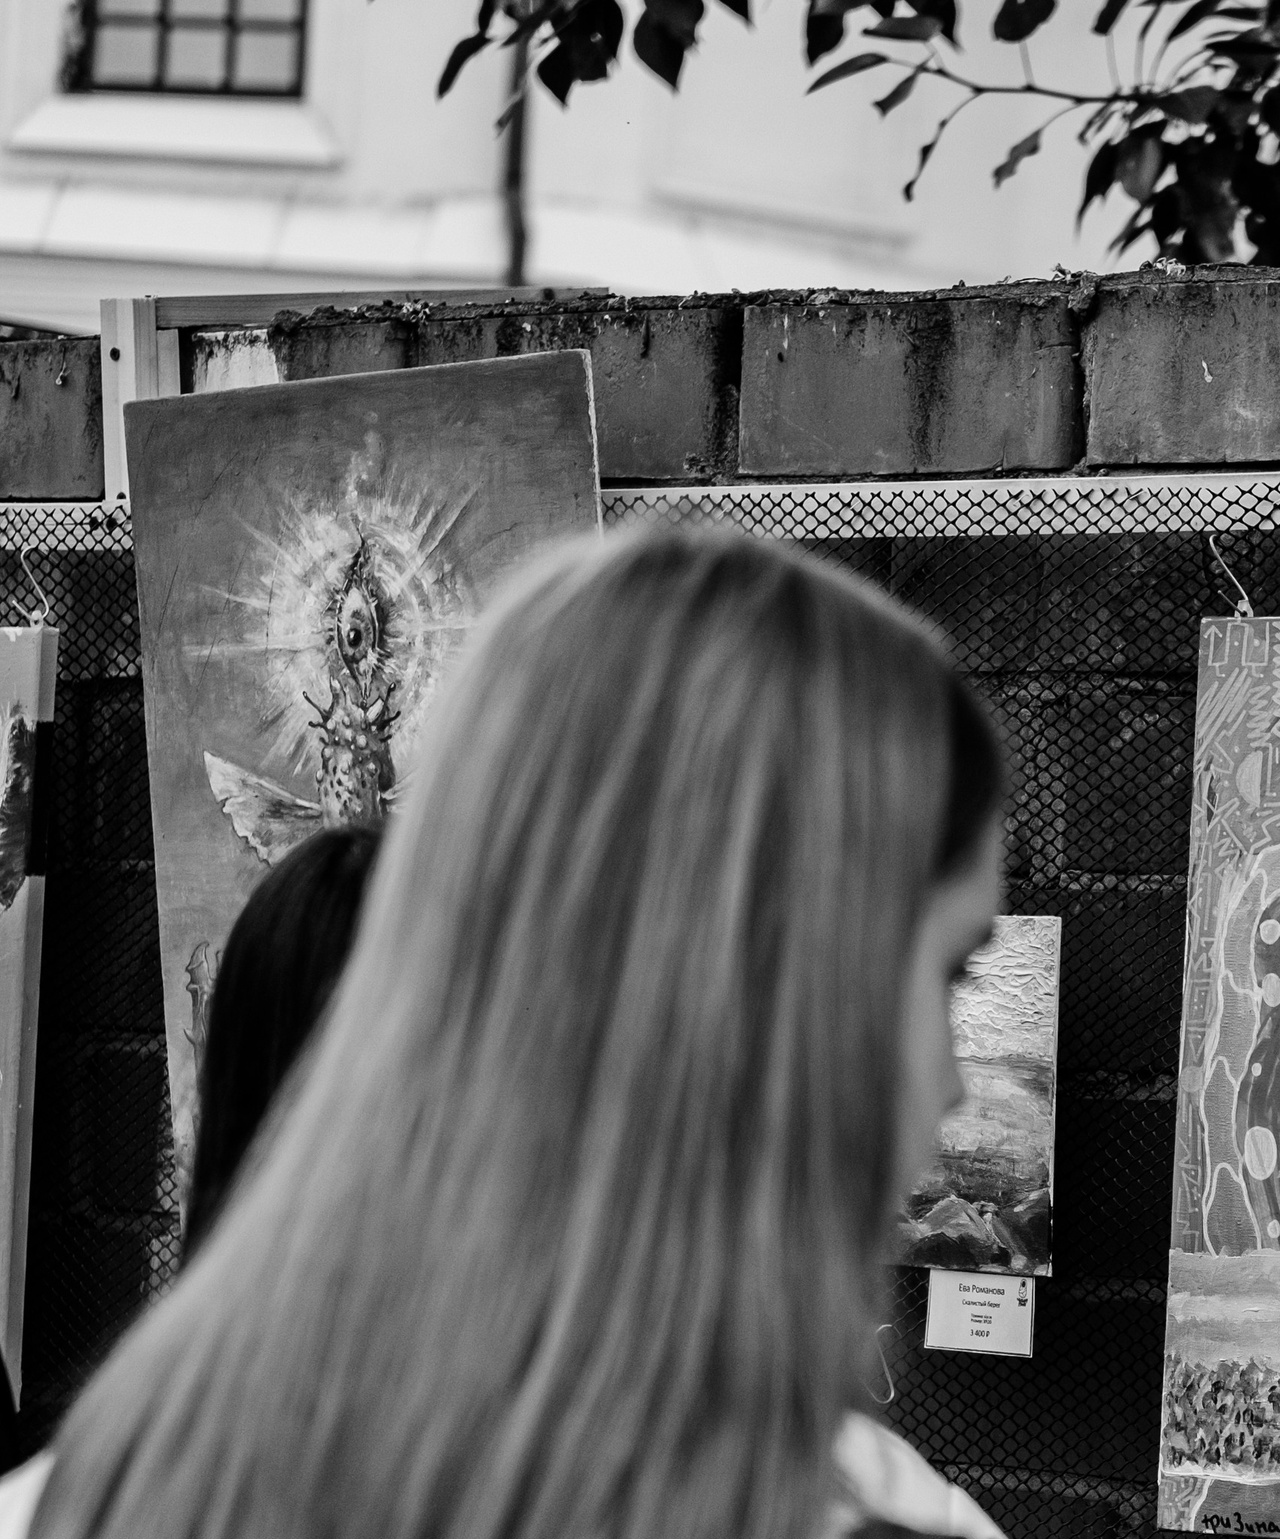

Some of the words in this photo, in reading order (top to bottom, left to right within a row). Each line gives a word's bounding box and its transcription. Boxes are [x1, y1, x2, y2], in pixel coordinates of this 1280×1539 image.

[959, 1283, 970, 1293] Ева
[972, 1284, 1005, 1296] Романова
[974, 1329, 985, 1338] 400
